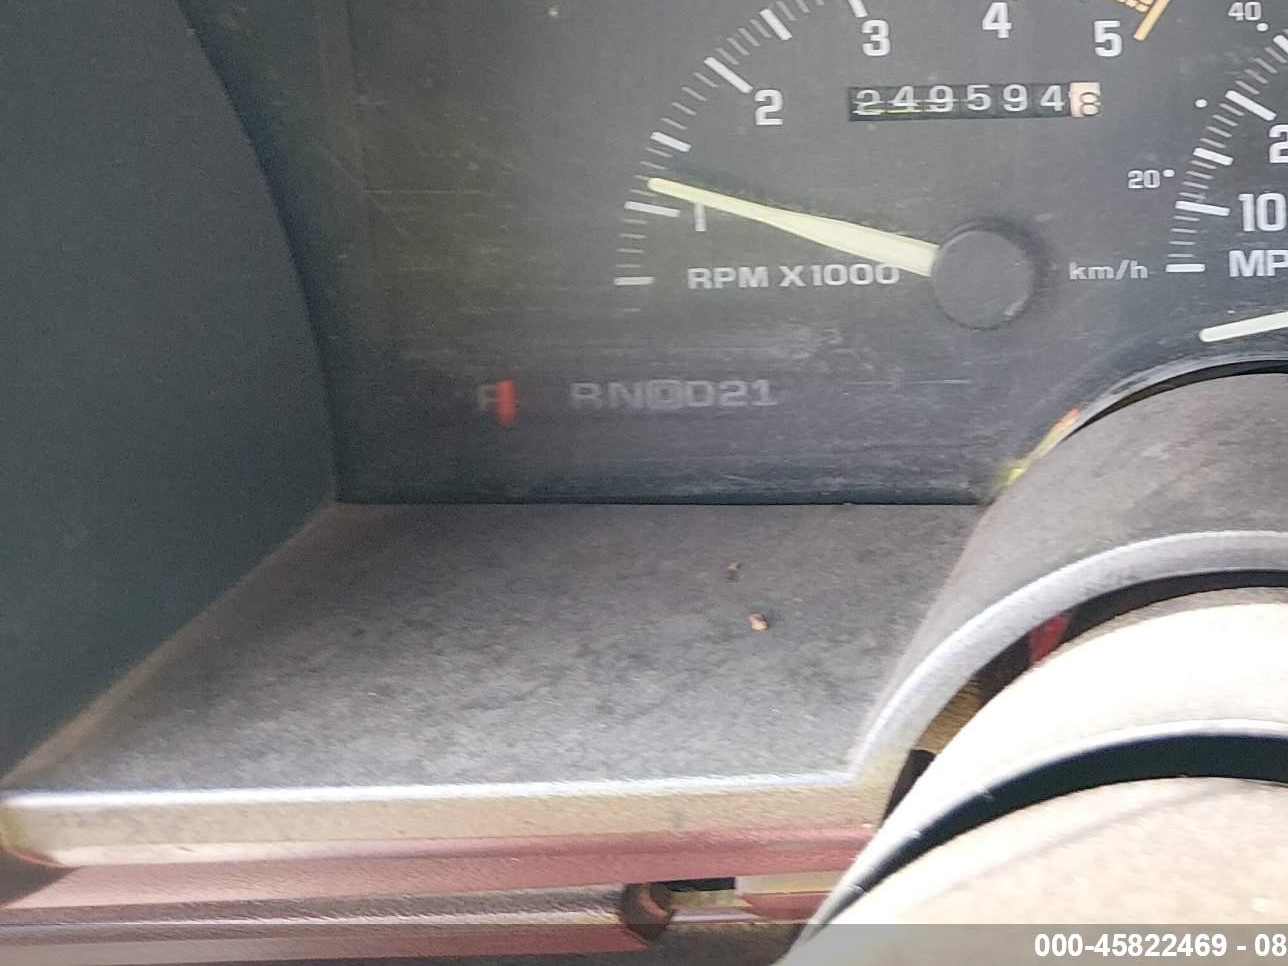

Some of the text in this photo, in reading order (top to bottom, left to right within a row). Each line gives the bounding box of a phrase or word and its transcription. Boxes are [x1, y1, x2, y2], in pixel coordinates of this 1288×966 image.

[982, 2, 1012, 38] 4
[1228, 1, 1262, 21] 40
[862, 19, 891, 57] 3
[1094, 20, 1123, 57] 5
[754, 89, 783, 125] 2
[1127, 170, 1160, 189] 20
[1238, 193, 1287, 232] 10
[687, 266, 769, 289] RPM
[1069, 259, 1148, 280] km/h
